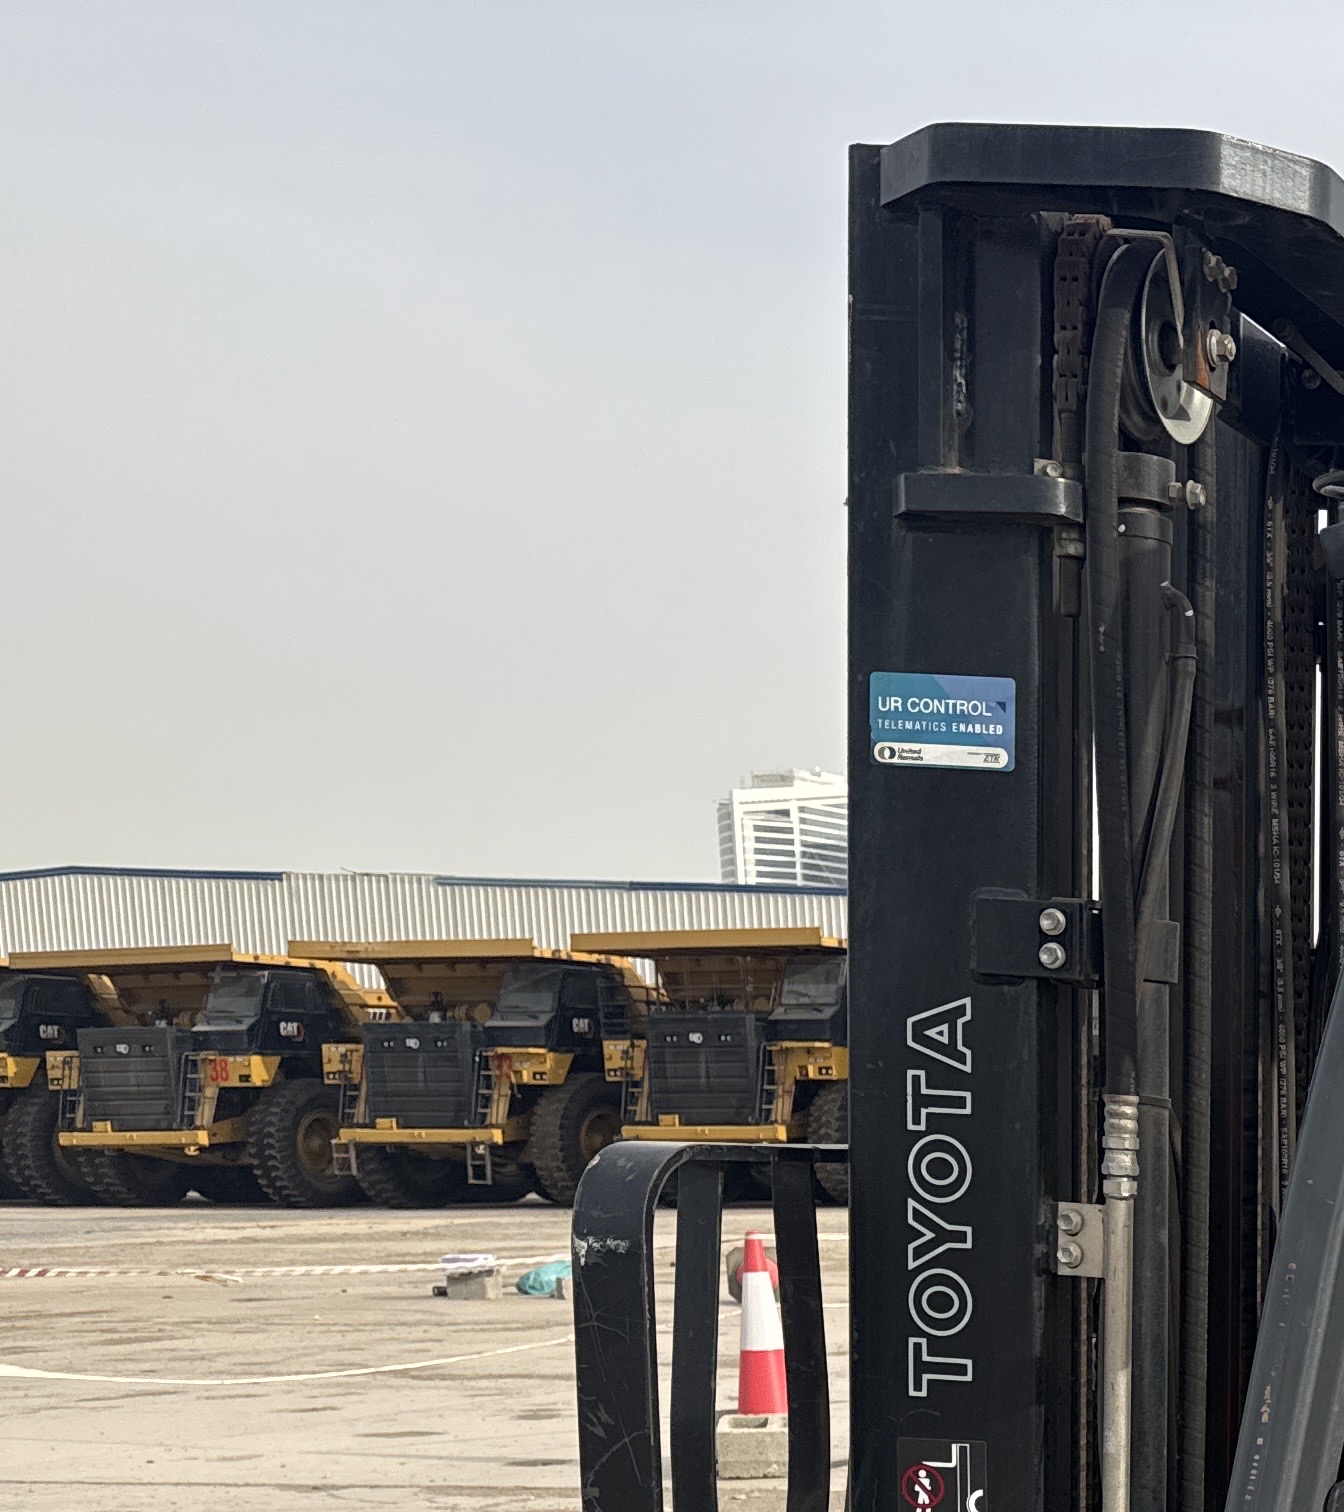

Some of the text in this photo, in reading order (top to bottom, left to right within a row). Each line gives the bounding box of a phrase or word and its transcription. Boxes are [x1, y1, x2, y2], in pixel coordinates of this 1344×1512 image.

[878, 696, 992, 716] UR CONTROL
[877, 719, 1003, 735] TELEMATICS ENABLED
[39, 1024, 59, 1039] CAT
[279, 1022, 299, 1037] CAT
[572, 1018, 589, 1033] CAT
[209, 1058, 230, 1082] 38
[907, 997, 973, 1397] TOYOTA
